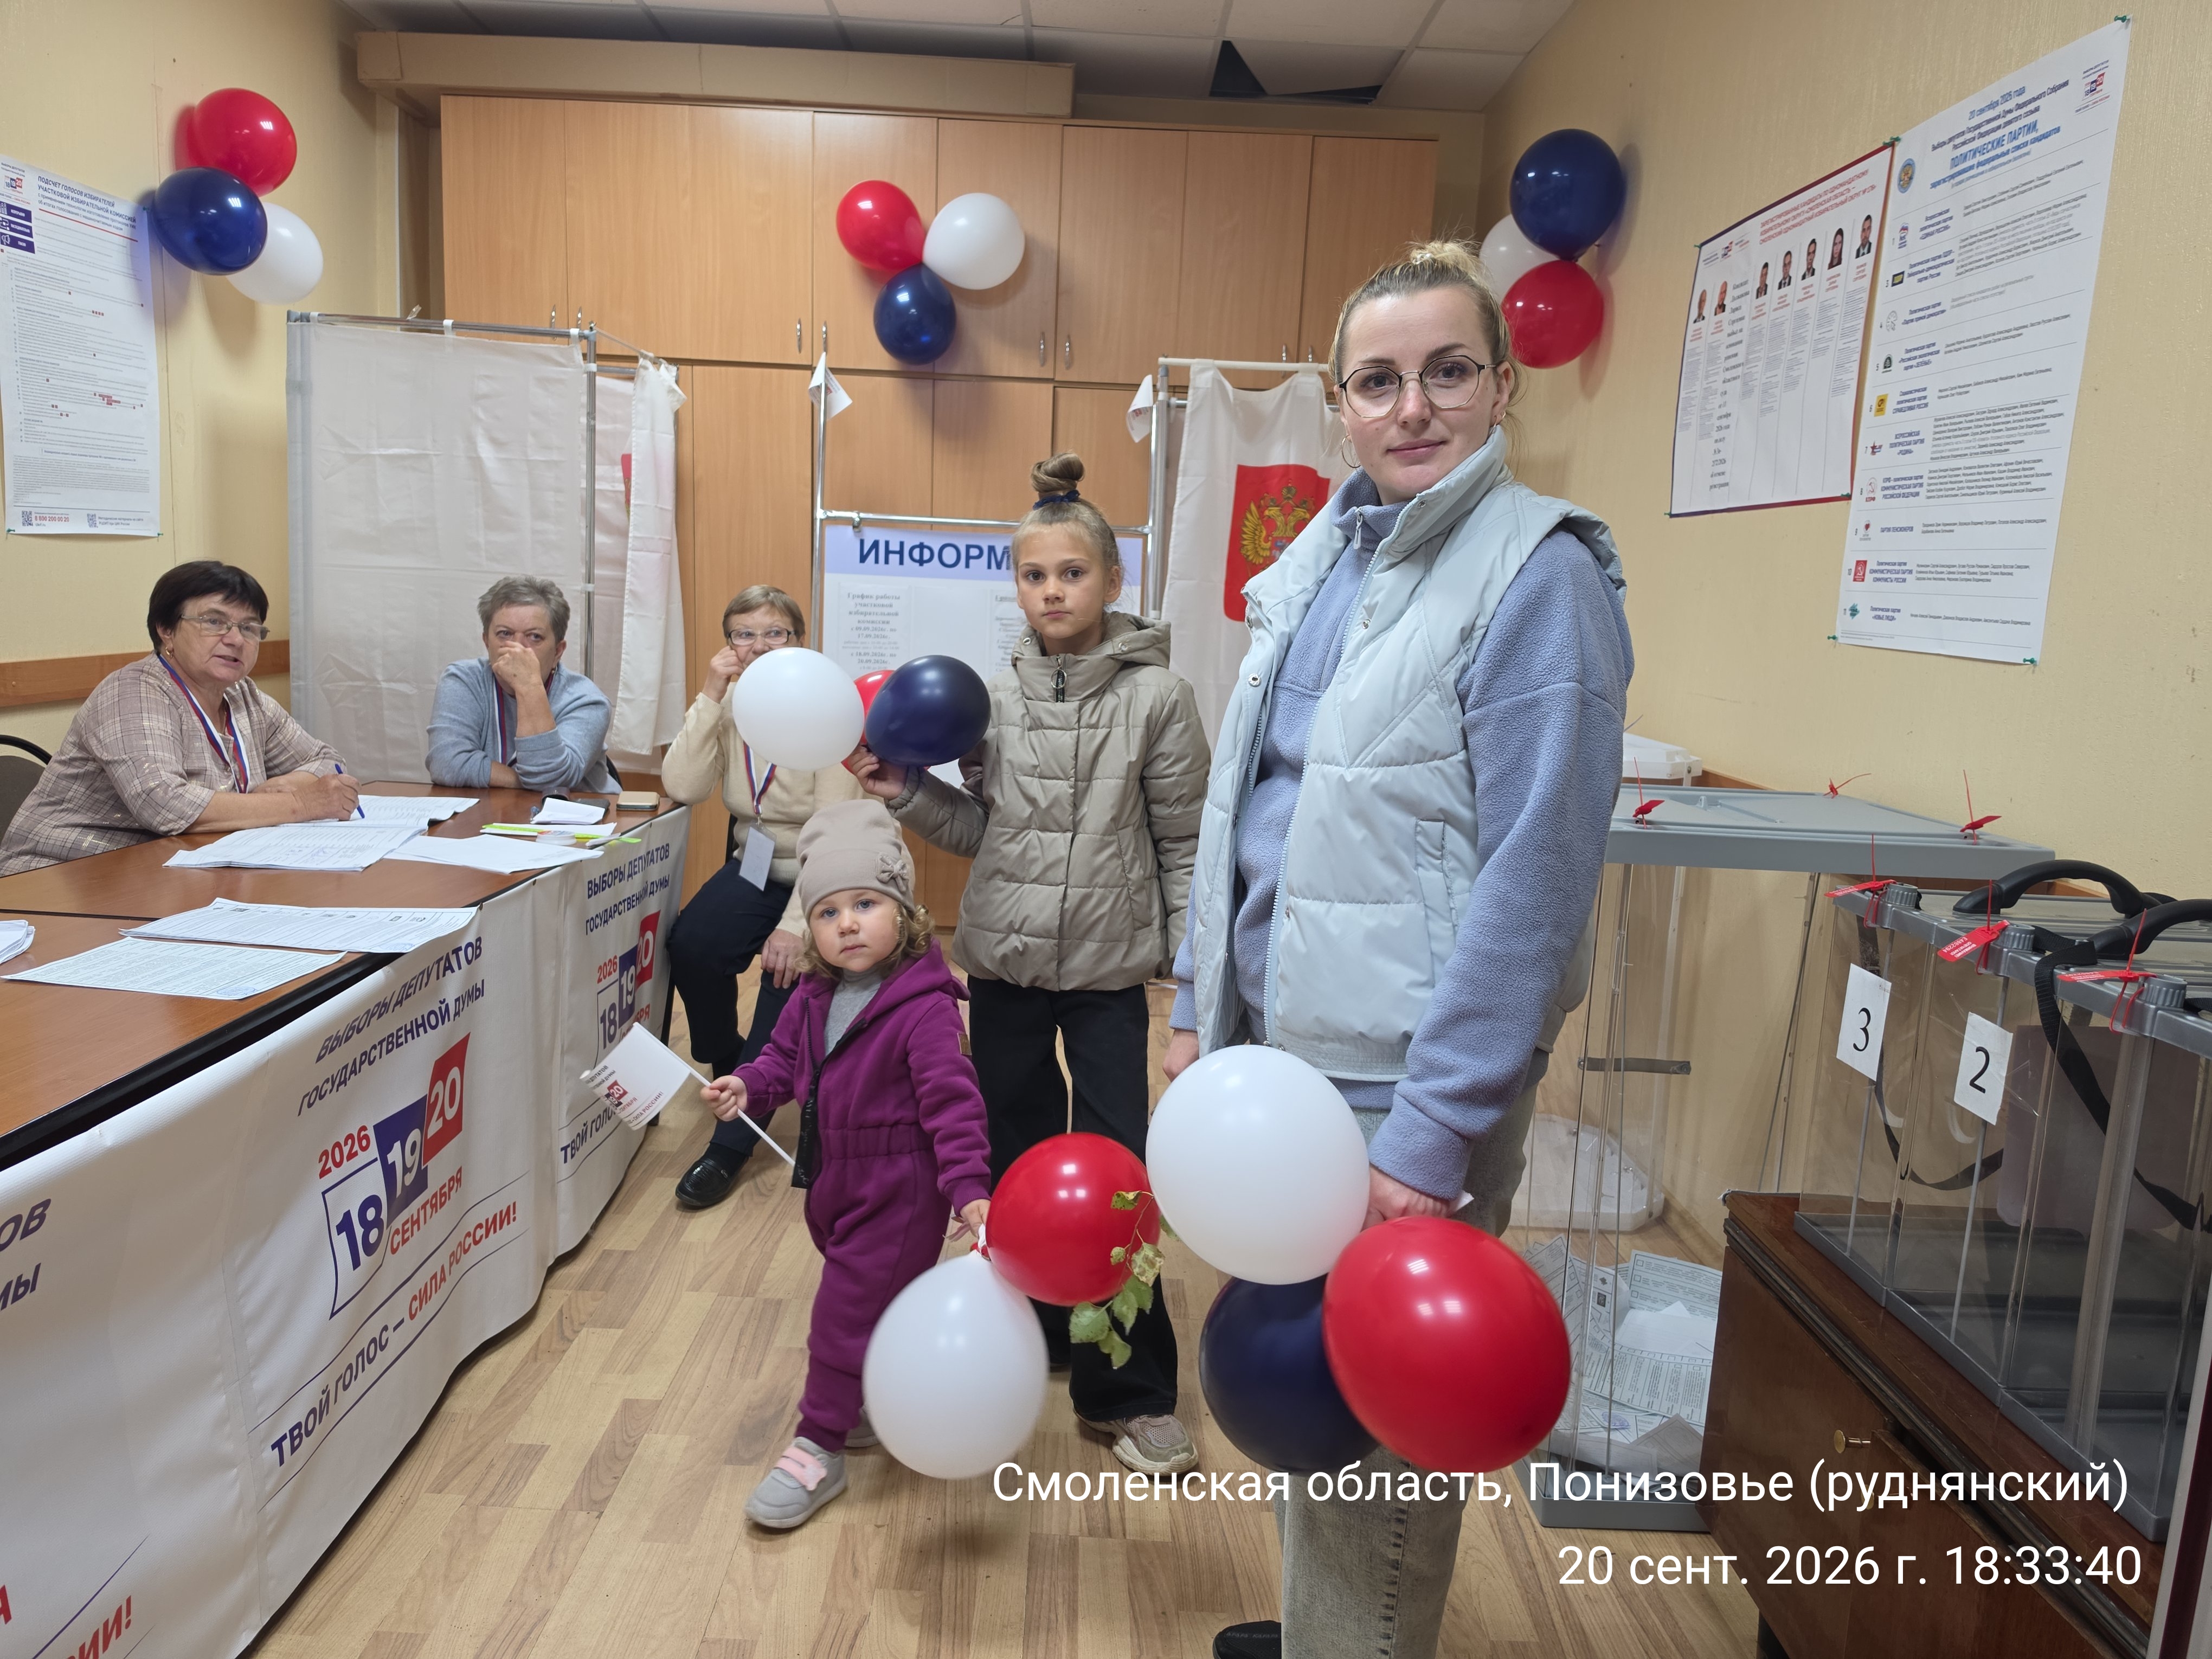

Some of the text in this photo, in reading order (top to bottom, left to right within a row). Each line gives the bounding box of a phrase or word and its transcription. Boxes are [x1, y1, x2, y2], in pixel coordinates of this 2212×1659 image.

[2096, 76, 2103, 85] 20
[1949, 119, 2040, 169] ПОЛИТИЧЕСКИЕ ПАРТИИ,
[5, 181, 11, 189] 18
[10, 179, 16, 188] 19
[15, 179, 22, 187] 20
[37, 176, 115, 208] ПОДСЧЕТ ГОЛОСОВ ИЗБИРАТЕЛЕЙ
[37, 185, 136, 223] УЧАСТКОВОЙ ИЗБИРАТЕЛЬНОЙ КОМИССИЕЙ
[859, 538, 1011, 570] ИНФОРМ
[587, 843, 670, 899] ВЫБОРЫ ДЕПУТАТОВ
[586, 874, 670, 935] ГОСУДАРСТВЕННОЙ ДУМЫ
[597, 955, 618, 985] 2026
[637, 930, 654, 974] 20
[315, 990, 396, 1064] ВЫБОРЫ
[391, 936, 483, 1013] ДЕПУТАТОВ
[621, 963, 636, 1010] 19
[297, 979, 485, 1117] ГОСУДАРСТВЕННОЙ ДУМЫ
[600, 1002, 618, 1051] 18
[1852, 1007, 1872, 1052] 3
[610, 1085, 623, 1097] 20
[1969, 1046, 1990, 1094] 2
[427, 1066, 461, 1130] 20
[318, 1124, 372, 1180] 2026
[561, 1106, 616, 1163] ТВОЙ ГОЛО
[387, 1128, 422, 1199] 19
[335, 1193, 385, 1272] 18
[390, 1166, 464, 1255] СЕНТЯБРЯ
[271, 1384, 331, 1468] ТВОЙ
[333, 1323, 390, 1405] ГОЛОС
[408, 1264, 447, 1321] СИЛА
[448, 1200, 517, 1276] РОССИИ!
